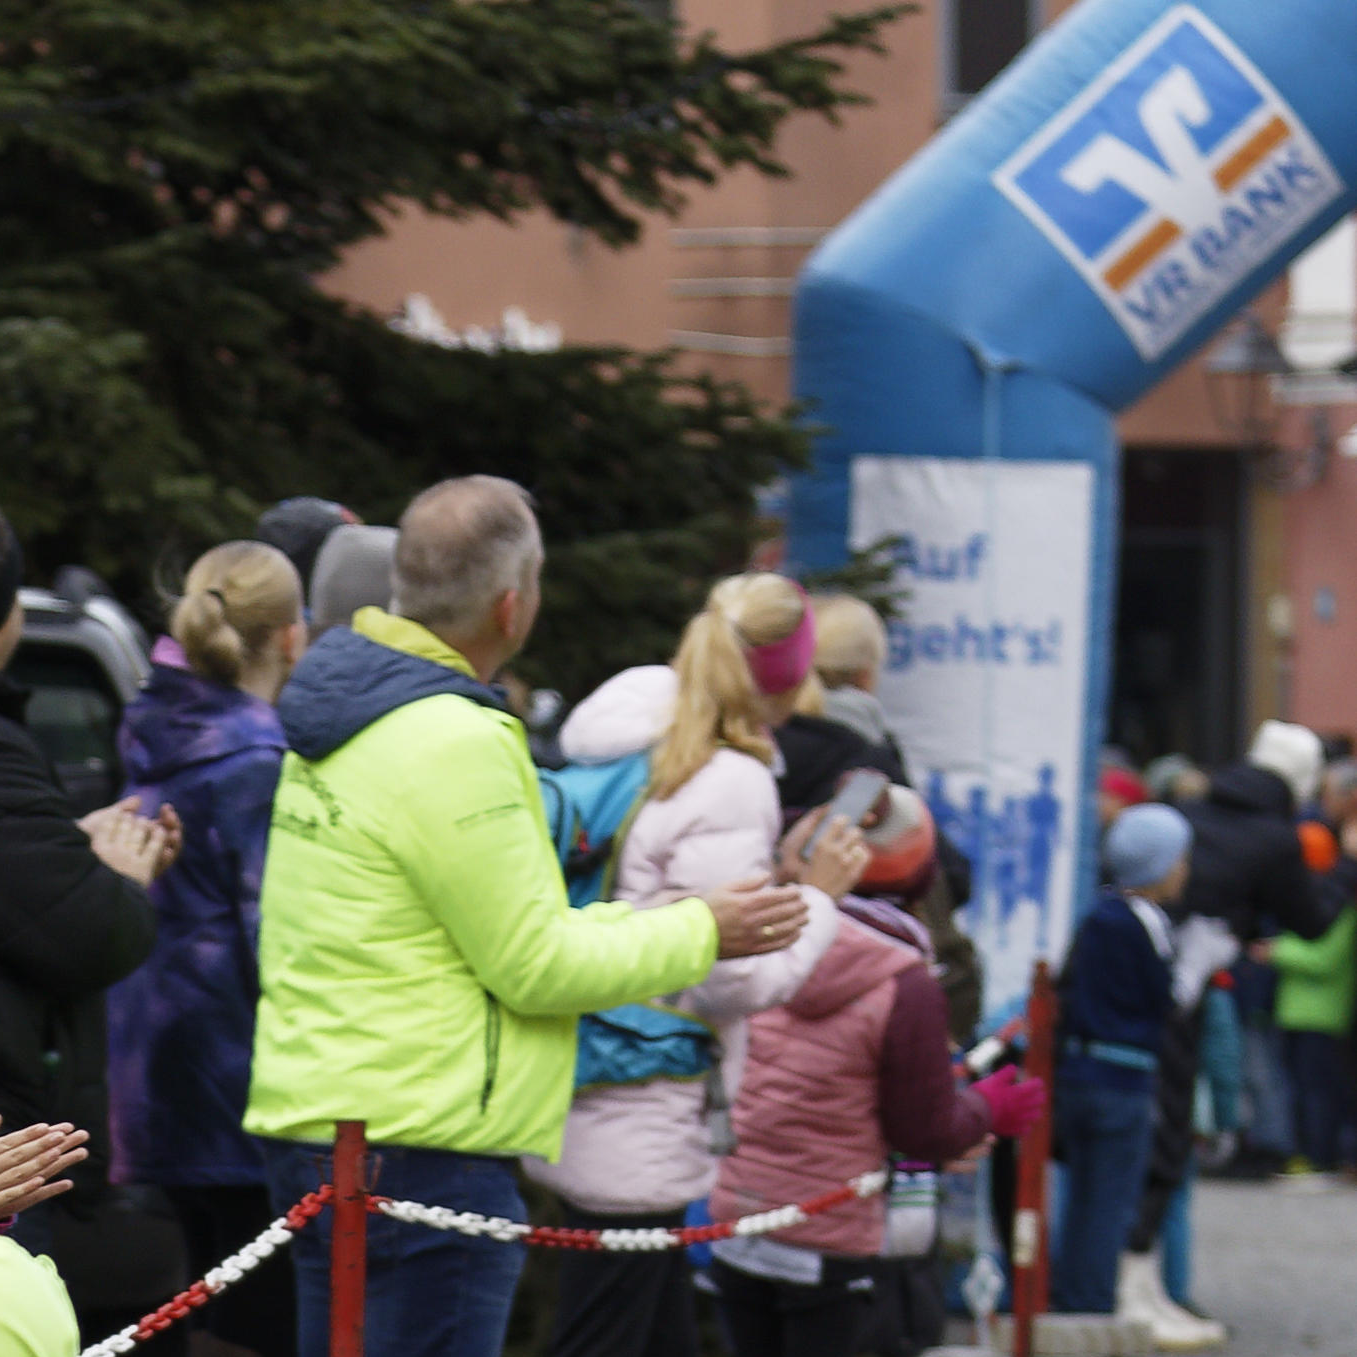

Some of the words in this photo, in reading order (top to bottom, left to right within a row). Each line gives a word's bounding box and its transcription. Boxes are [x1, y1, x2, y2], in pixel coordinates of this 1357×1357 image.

[1124, 257, 1192, 324] VR
[1190, 149, 1319, 270] BANK
[887, 615, 1063, 675] geht's!
